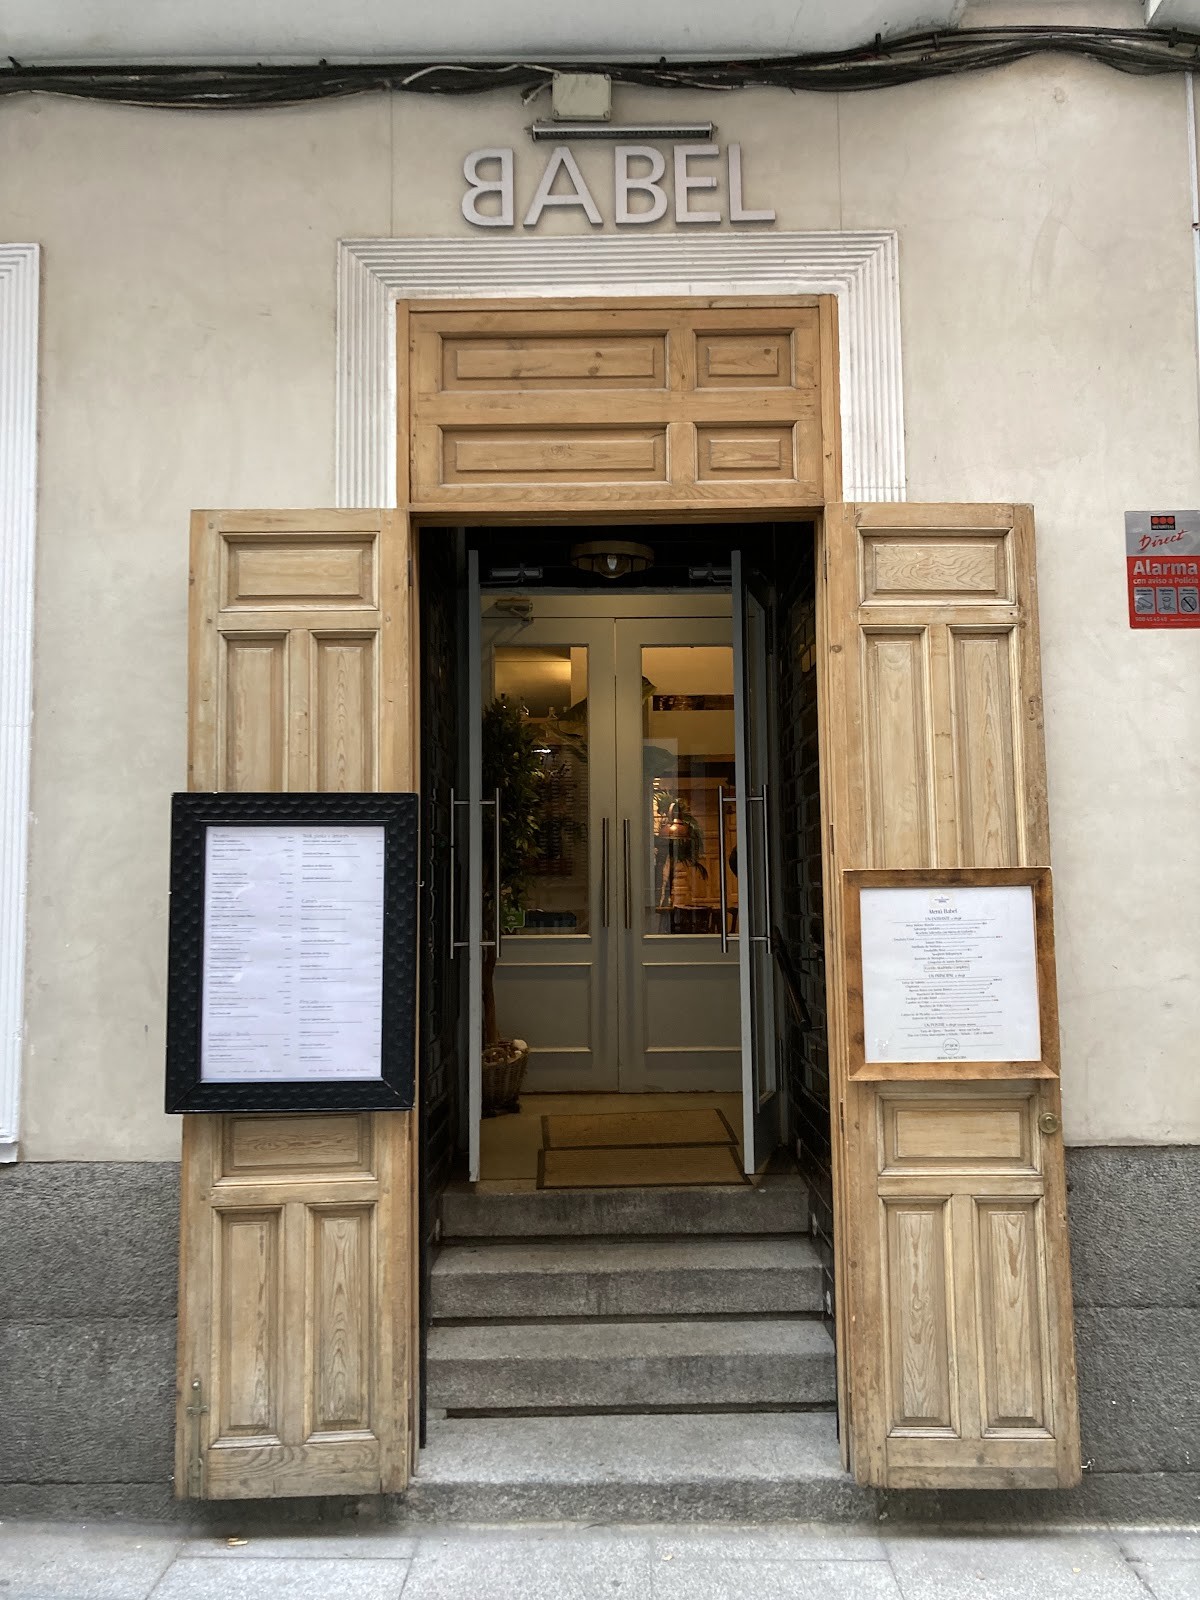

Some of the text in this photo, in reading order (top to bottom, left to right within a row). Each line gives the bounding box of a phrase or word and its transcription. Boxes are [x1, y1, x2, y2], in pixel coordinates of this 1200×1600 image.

[461, 143, 776, 226] BABEL
[1139, 530, 1188, 551] Direct
[1133, 559, 1198, 576] Alarma
[1133, 577, 1147, 585] con
[1147, 576, 1167, 584] aviso
